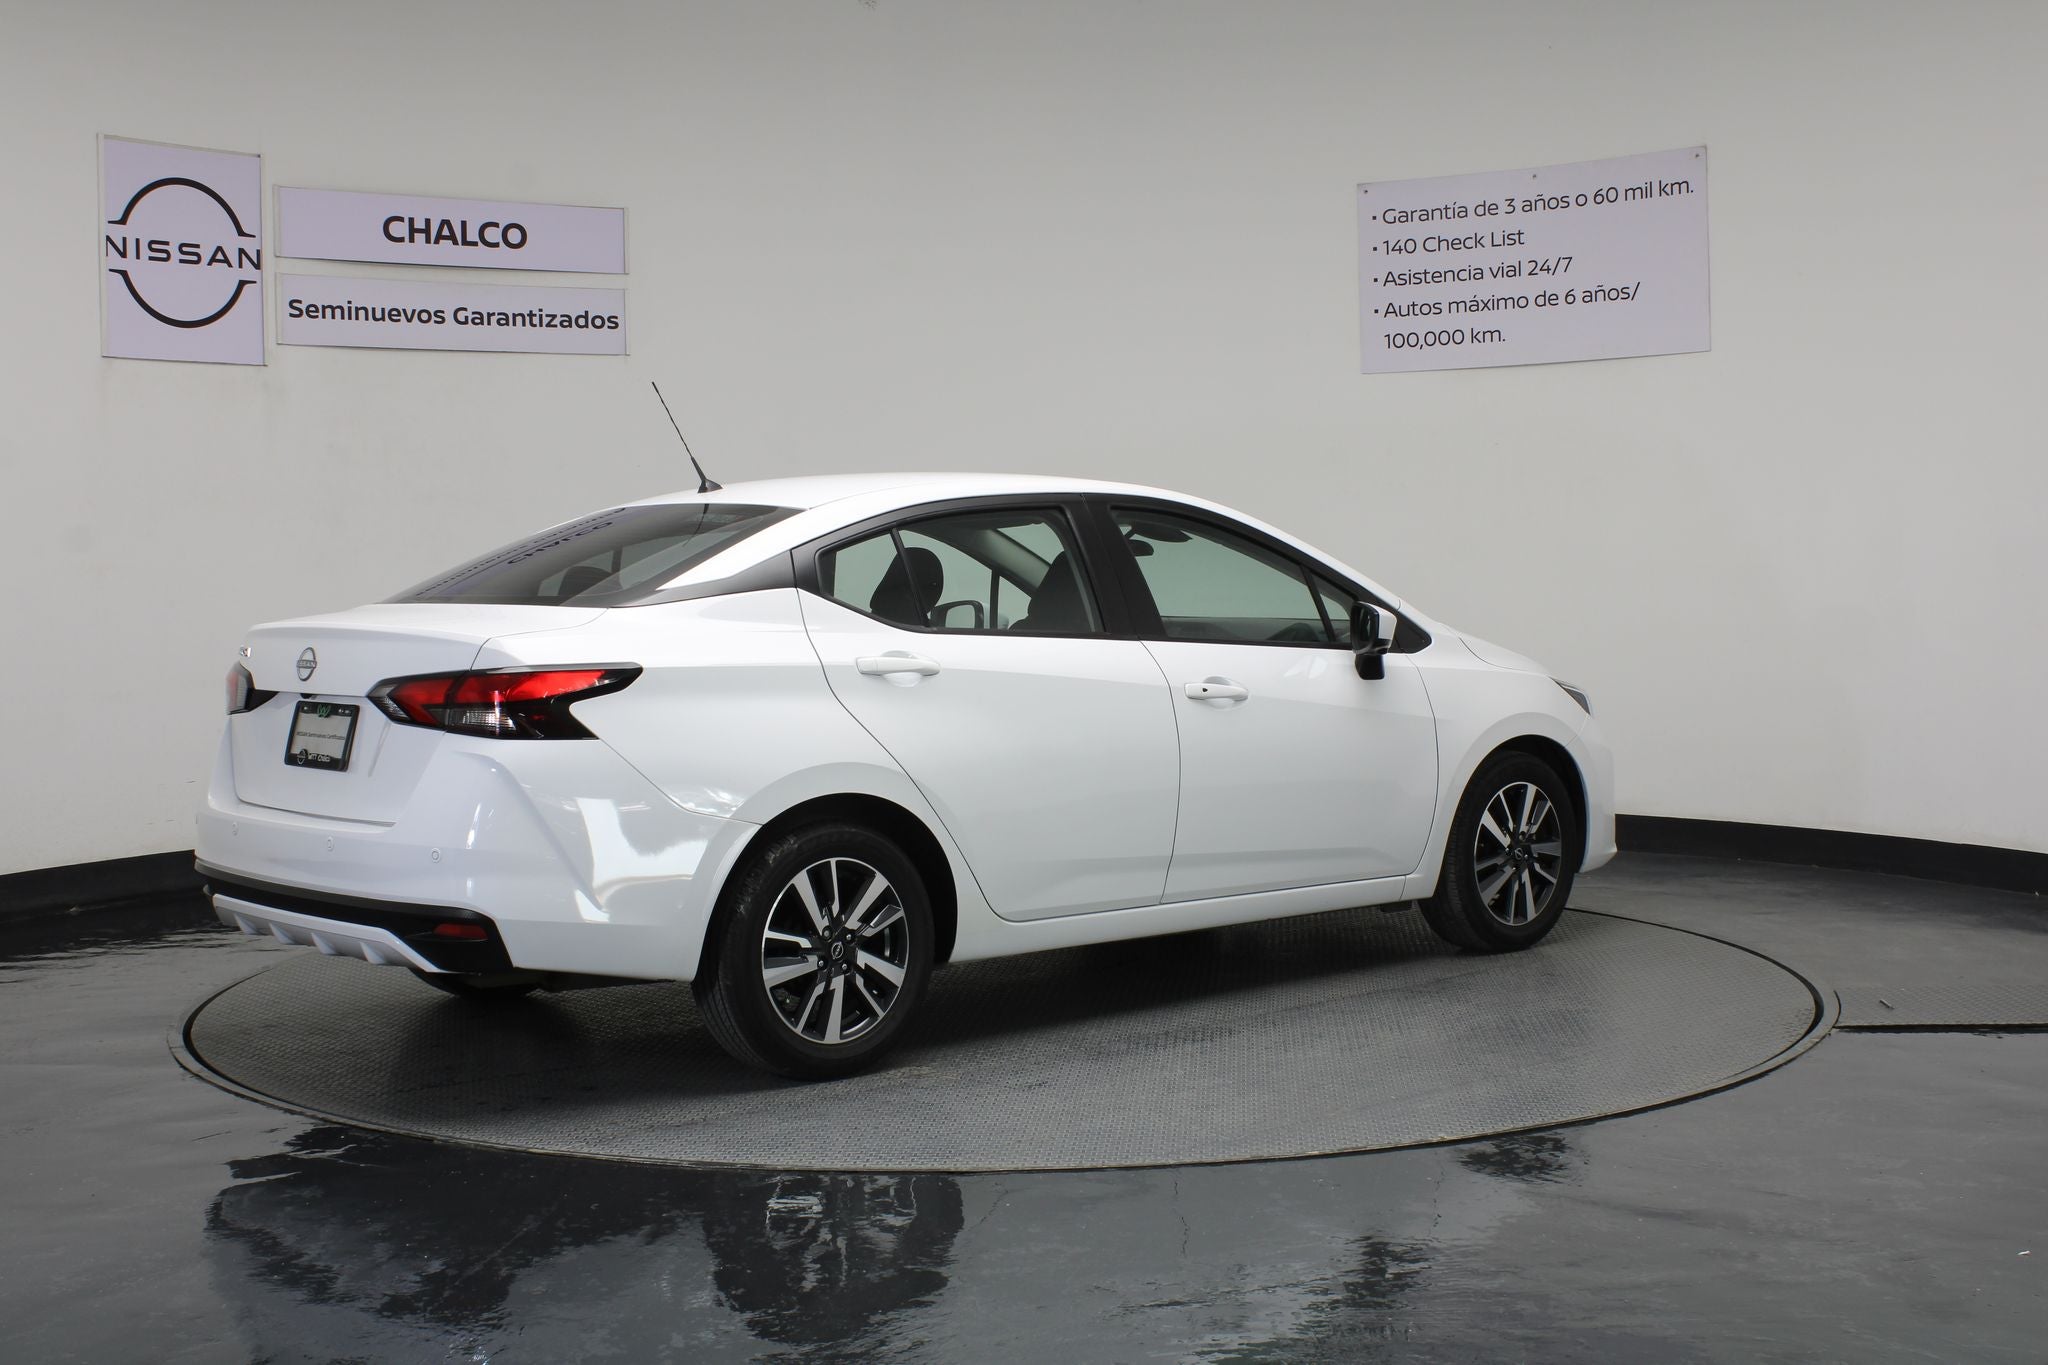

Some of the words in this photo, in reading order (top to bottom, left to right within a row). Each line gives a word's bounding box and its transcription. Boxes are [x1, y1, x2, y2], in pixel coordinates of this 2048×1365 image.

[1382, 201, 1469, 225] Garantía
[1473, 199, 1499, 218] de
[1504, 197, 1516, 215] 3
[1521, 193, 1571, 213] años
[1574, 193, 1588, 208] o
[1592, 186, 1619, 206] 60
[1624, 180, 1653, 202] mil
[1658, 179, 1694, 198] km.
[382, 215, 528, 250] CHALCO
[1382, 237, 1417, 256] 140
[1422, 232, 1486, 253] Check
[1490, 229, 1525, 248] List
[105, 234, 262, 271] NISSAN
[1382, 268, 1484, 288] Asistencia
[1488, 259, 1522, 280] vial
[1527, 256, 1573, 277] 24/7
[288, 298, 446, 325] Seminuevos
[452, 306, 620, 331] Garantizados
[1383, 299, 1443, 319] Autos
[1448, 294, 1530, 314] máximo
[1534, 289, 1560, 308] de
[1564, 288, 1577, 305] 6
[1581, 281, 1641, 304] años/
[1383, 328, 1465, 351] 100,000
[1470, 327, 1506, 344] km.
